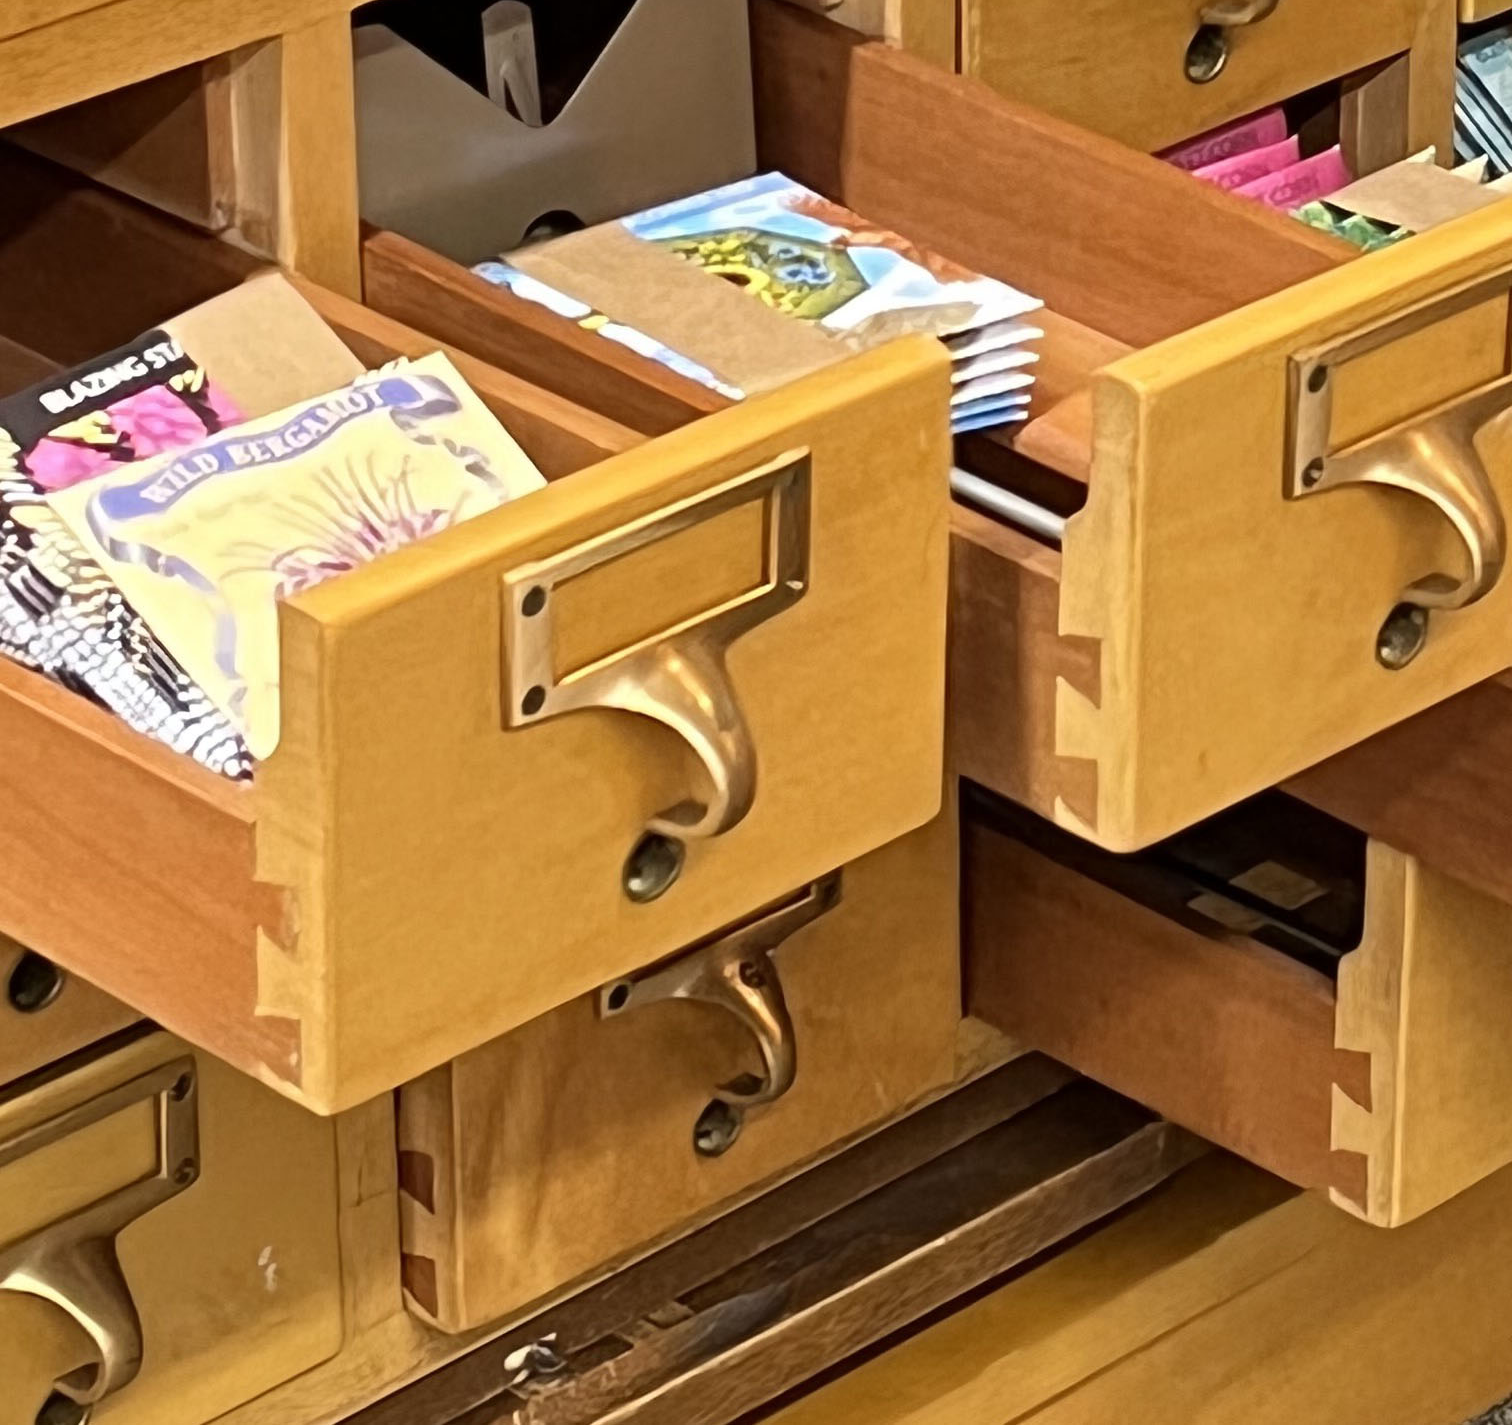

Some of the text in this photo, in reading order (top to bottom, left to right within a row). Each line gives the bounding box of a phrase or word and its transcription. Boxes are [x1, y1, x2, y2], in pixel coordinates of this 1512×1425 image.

[39, 339, 185, 414] BLAZING STA
[139, 385, 385, 503] WILD BERGAMOT
